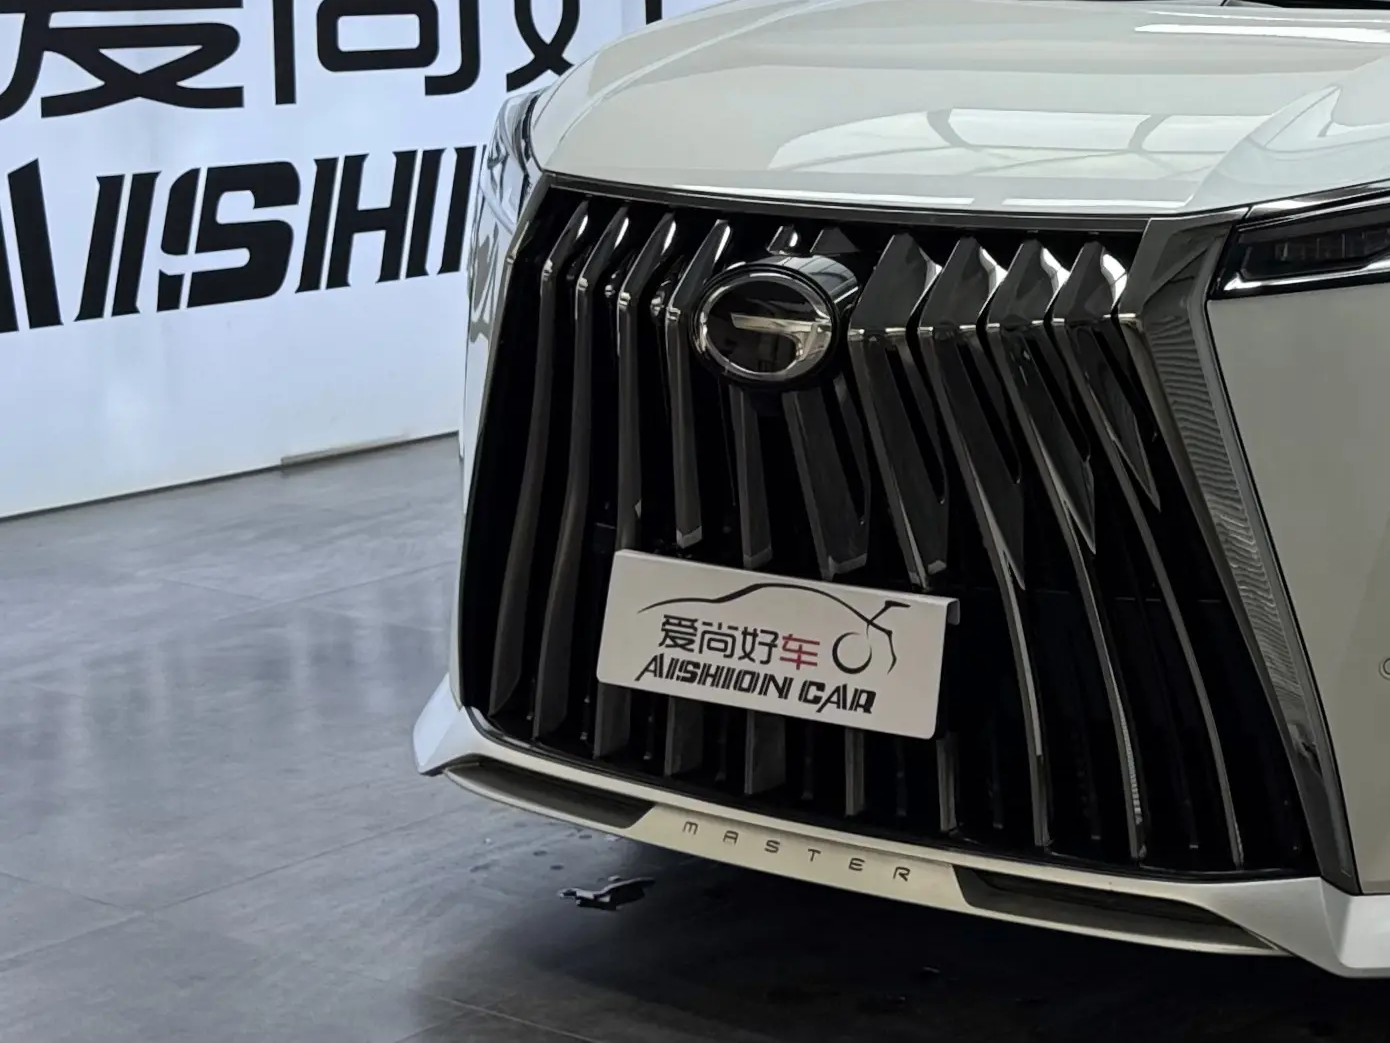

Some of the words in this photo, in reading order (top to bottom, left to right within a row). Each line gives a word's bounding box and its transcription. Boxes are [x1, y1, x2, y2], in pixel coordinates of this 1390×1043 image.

[658, 614, 820, 670] 爱尚好车
[634, 653, 794, 700] AISHION
[797, 679, 877, 714] CAR
[682, 820, 911, 882] MASTER
